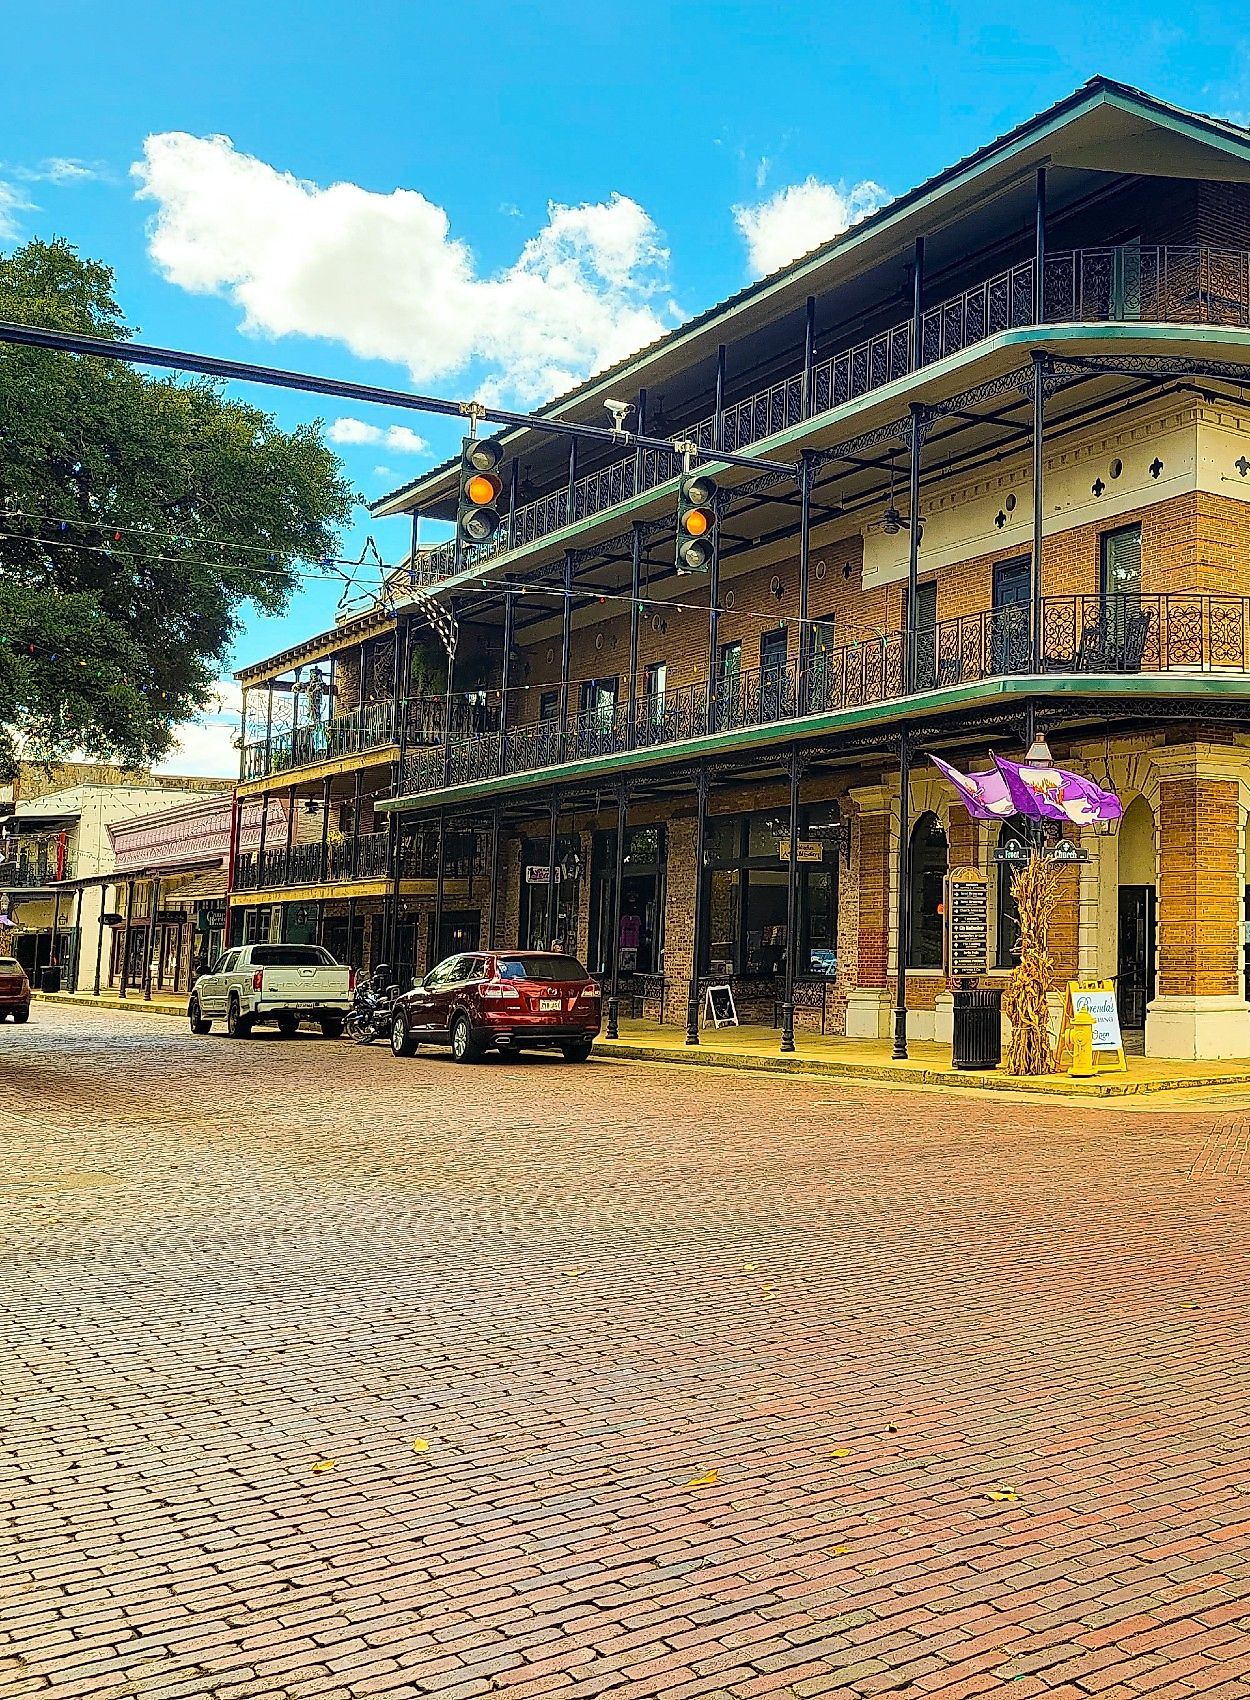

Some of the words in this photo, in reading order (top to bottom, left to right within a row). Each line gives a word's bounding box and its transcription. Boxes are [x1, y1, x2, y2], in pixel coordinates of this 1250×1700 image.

[1005, 850, 1020, 858] Front
[1054, 850, 1077, 858] Church
[1076, 996, 1115, 1013] Brenda's
[1091, 1029, 1110, 1041] Open
